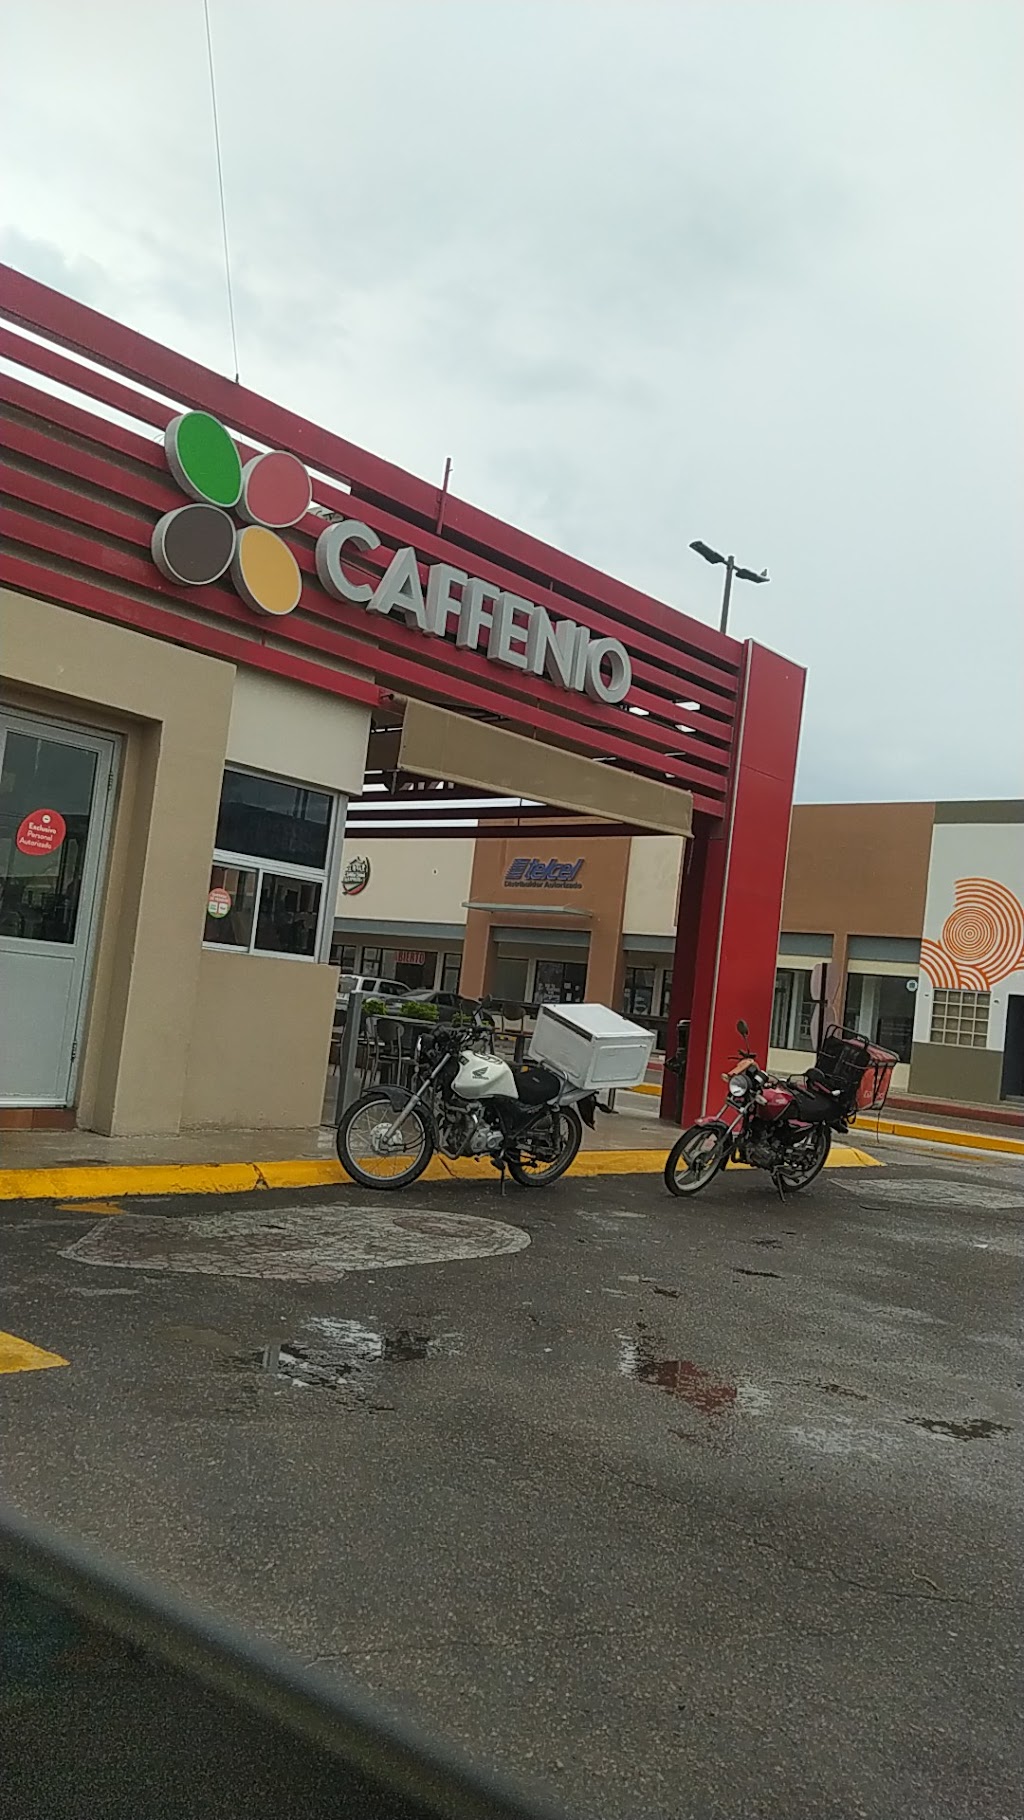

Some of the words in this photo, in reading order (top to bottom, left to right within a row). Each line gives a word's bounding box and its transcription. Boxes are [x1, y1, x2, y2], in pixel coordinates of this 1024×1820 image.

[315, 519, 632, 703] CAFFENIO
[28, 822, 57, 835] Exclusivo
[27, 830, 53, 842] Personal
[19, 837, 52, 850] Autorizado
[504, 880, 543, 888] Distribuidor
[544, 881, 583, 889] Autorizado
